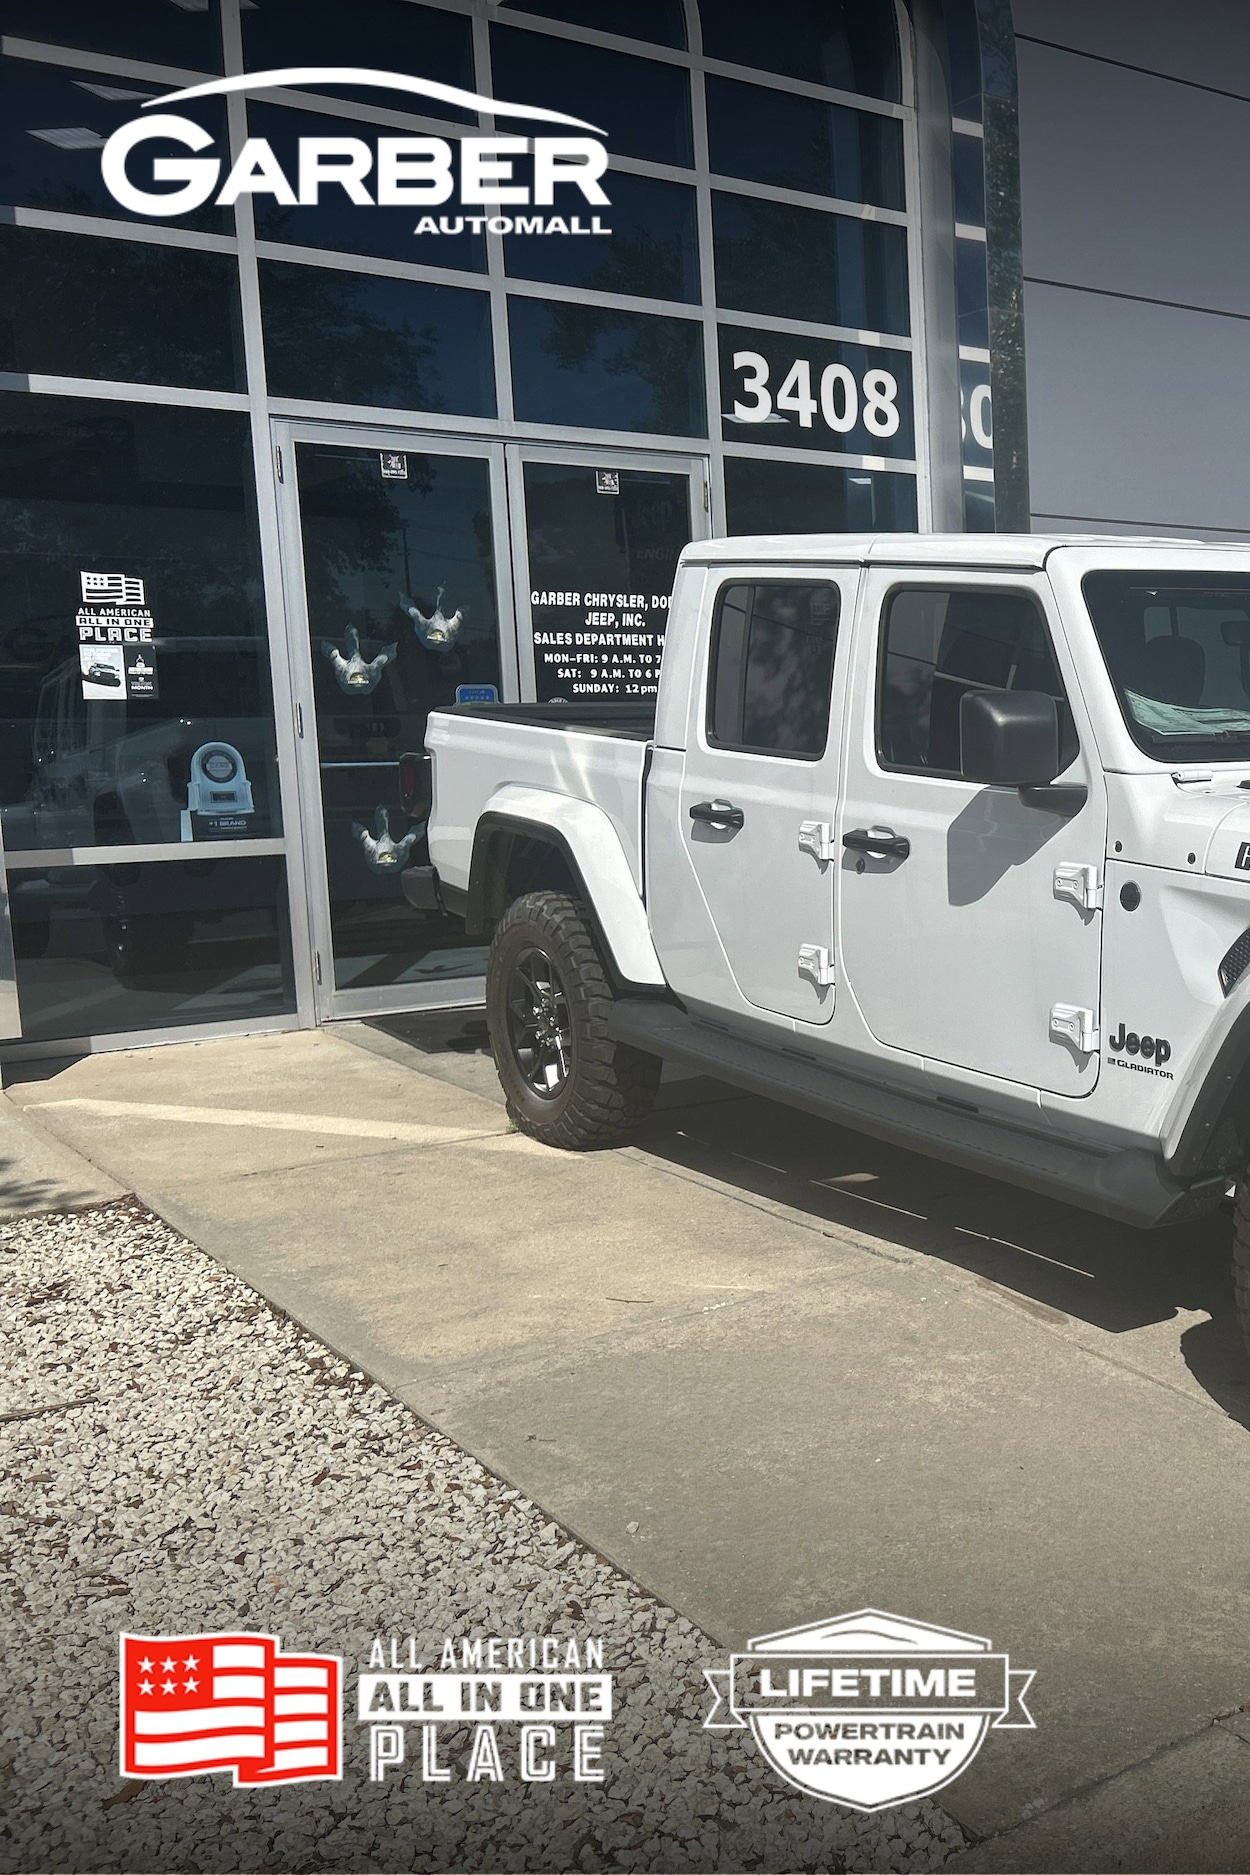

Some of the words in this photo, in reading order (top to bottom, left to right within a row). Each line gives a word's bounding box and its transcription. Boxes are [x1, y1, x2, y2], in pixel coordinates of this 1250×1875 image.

[733, 351, 900, 438] 3408
[531, 591, 580, 606] GARBER
[584, 593, 649, 611] CHRYSLER,
[78, 608, 96, 616] ALL
[100, 608, 151, 617] AMERICAN
[585, 612, 619, 628] JEEP,
[622, 613, 646, 627] INC.
[79, 627, 153, 642] PLACE
[534, 632, 572, 645] SALES
[575, 633, 653, 646] DEPARTMENT
[601, 655, 608, 663] 9
[612, 655, 636, 664] A.M.
[639, 655, 652, 664] TO
[557, 669, 581, 678] SAT:
[591, 669, 597, 679] 9
[601, 669, 625, 679] A.M.
[628, 669, 642, 679] TO
[645, 669, 652, 679] 6
[572, 684, 619, 694] SUNDAY:
[1109, 1022, 1171, 1067] Jeep
[1117, 1059, 1174, 1080] GLADIATOR
